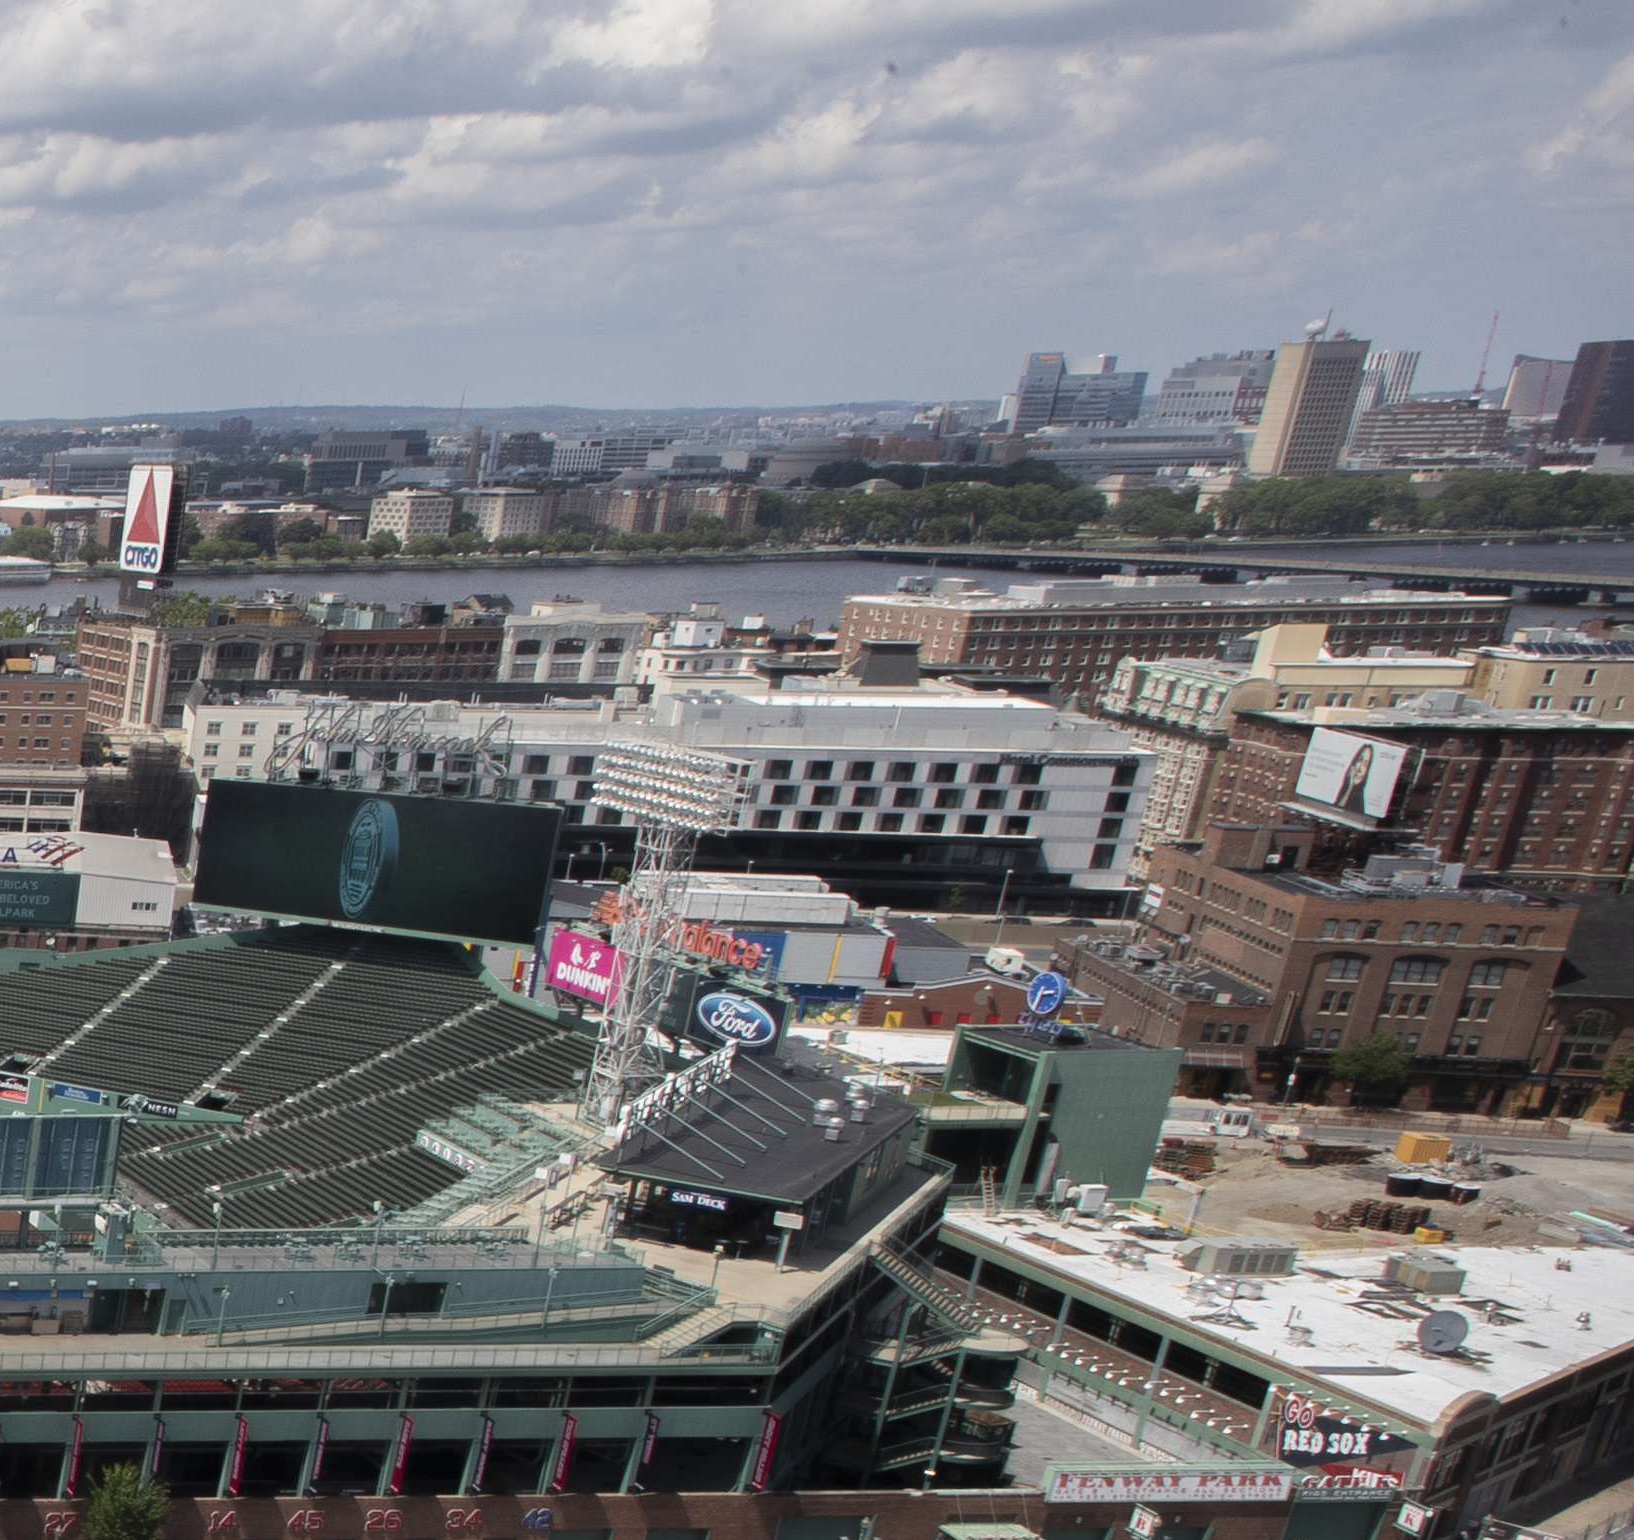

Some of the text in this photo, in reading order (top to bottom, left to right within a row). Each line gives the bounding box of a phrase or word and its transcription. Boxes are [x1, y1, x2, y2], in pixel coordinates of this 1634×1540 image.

[125, 545, 158, 569] CITGO
[0, 894, 50, 905] BELOVED
[556, 962, 611, 996] DUNKIN'
[711, 1000, 760, 1039] Ford
[147, 1103, 176, 1116] NESN
[672, 1192, 694, 1203] SAM
[697, 1196, 726, 1210] DECK
[1285, 1398, 1315, 1429] GO
[1283, 1429, 1372, 1455] RED SOX
[1058, 1472, 1282, 1488] FENWAY PARK
[45, 1512, 78, 1534] 27
[208, 1510, 236, 1532] 14
[287, 1510, 325, 1531] 45
[365, 1509, 402, 1531] 26
[446, 1508, 482, 1530] 34
[521, 1508, 553, 1530] 42
[1403, 1513, 1414, 1527] K
